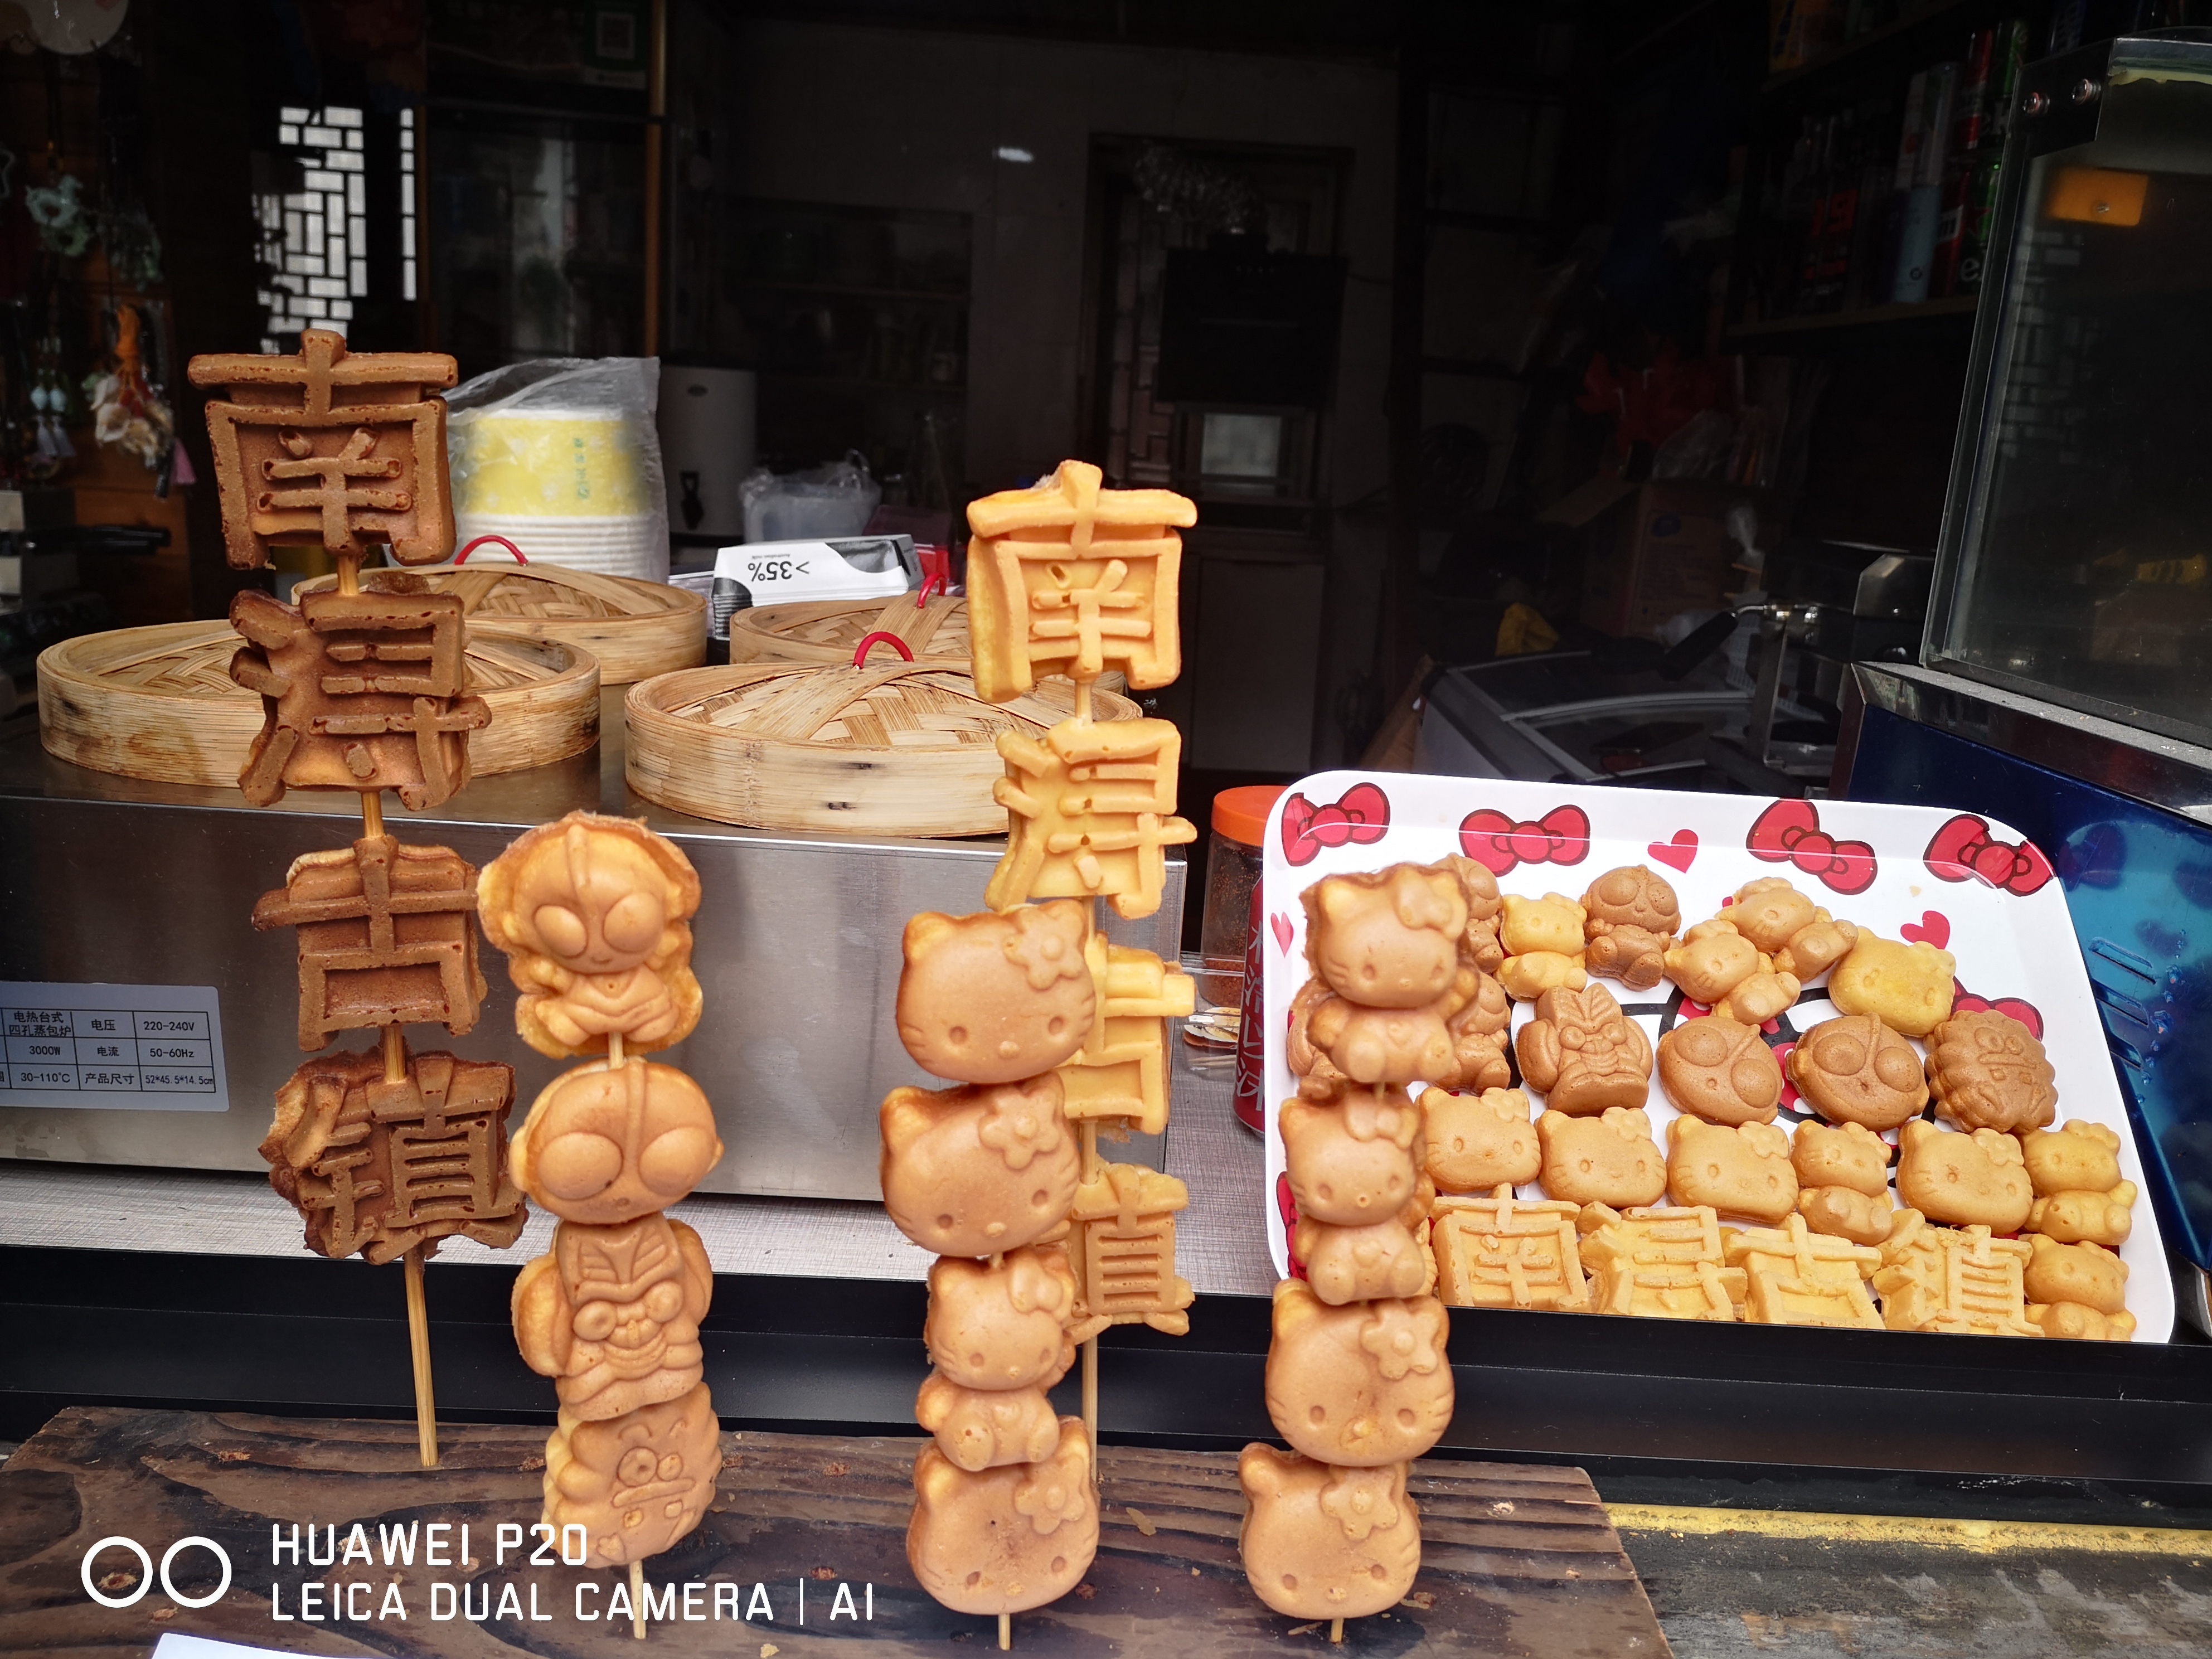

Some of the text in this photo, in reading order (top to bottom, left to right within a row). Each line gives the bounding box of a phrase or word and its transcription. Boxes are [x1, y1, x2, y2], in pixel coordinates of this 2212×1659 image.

[748, 561, 810, 582] >35%
[14, 1011, 64, 1023] 电热台式
[9, 1025, 72, 1037] 四孔蒸包炉
[91, 1019, 116, 1031] 电压
[143, 1021, 195, 1031] 220-240V
[29, 1045, 61, 1056] 3000W
[97, 1046, 120, 1057] 电流
[149, 1047, 195, 1058] 50-60Hz
[85, 1073, 134, 1085] 产品尺寸
